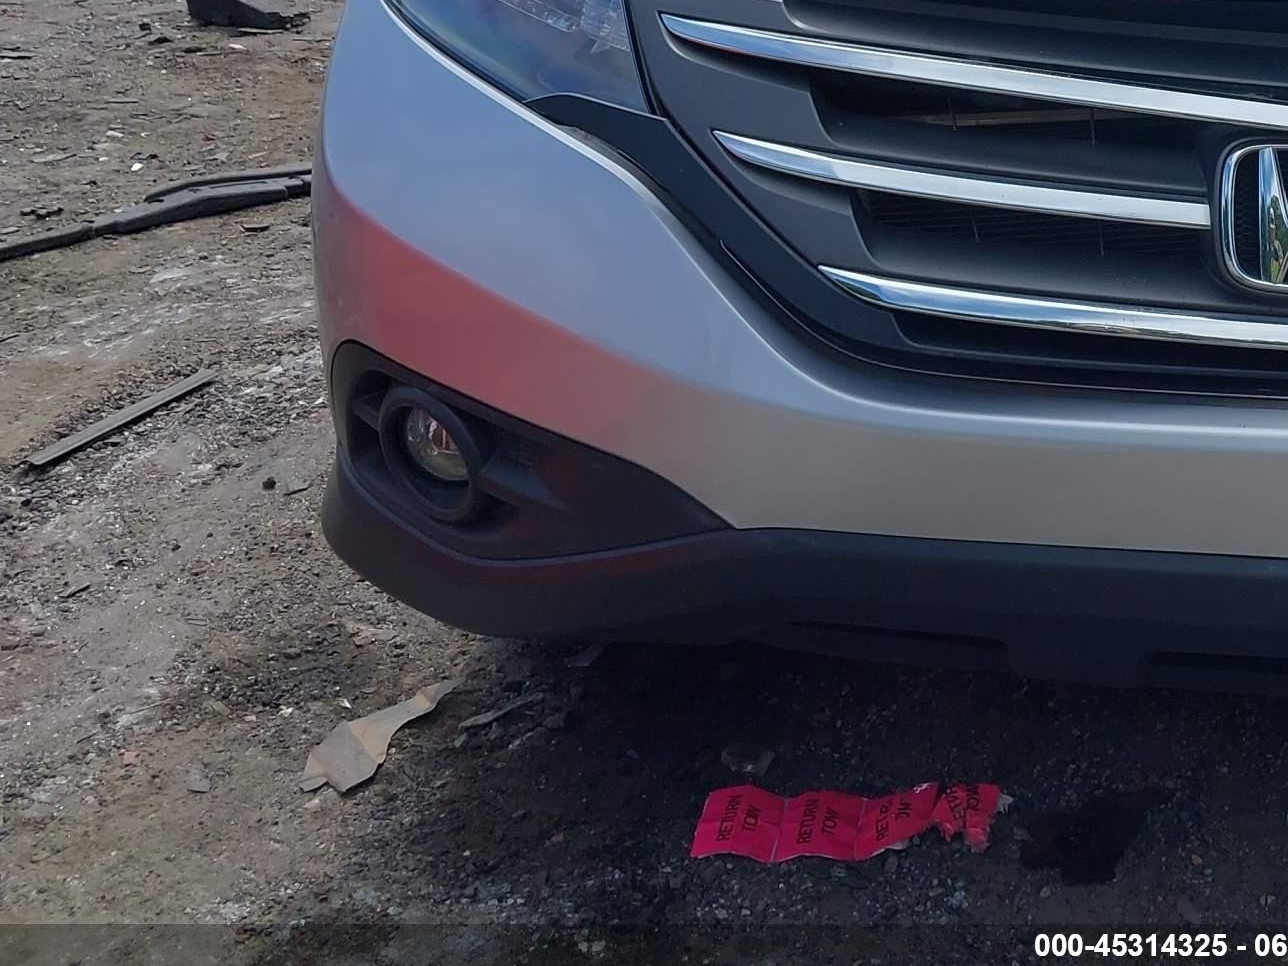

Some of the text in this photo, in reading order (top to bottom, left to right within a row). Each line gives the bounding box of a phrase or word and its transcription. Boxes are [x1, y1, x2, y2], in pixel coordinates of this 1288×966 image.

[716, 793, 744, 843] RETURN
[740, 803, 762, 832] TOW
[796, 797, 822, 845] RETURN
[821, 806, 840, 836] TOW
